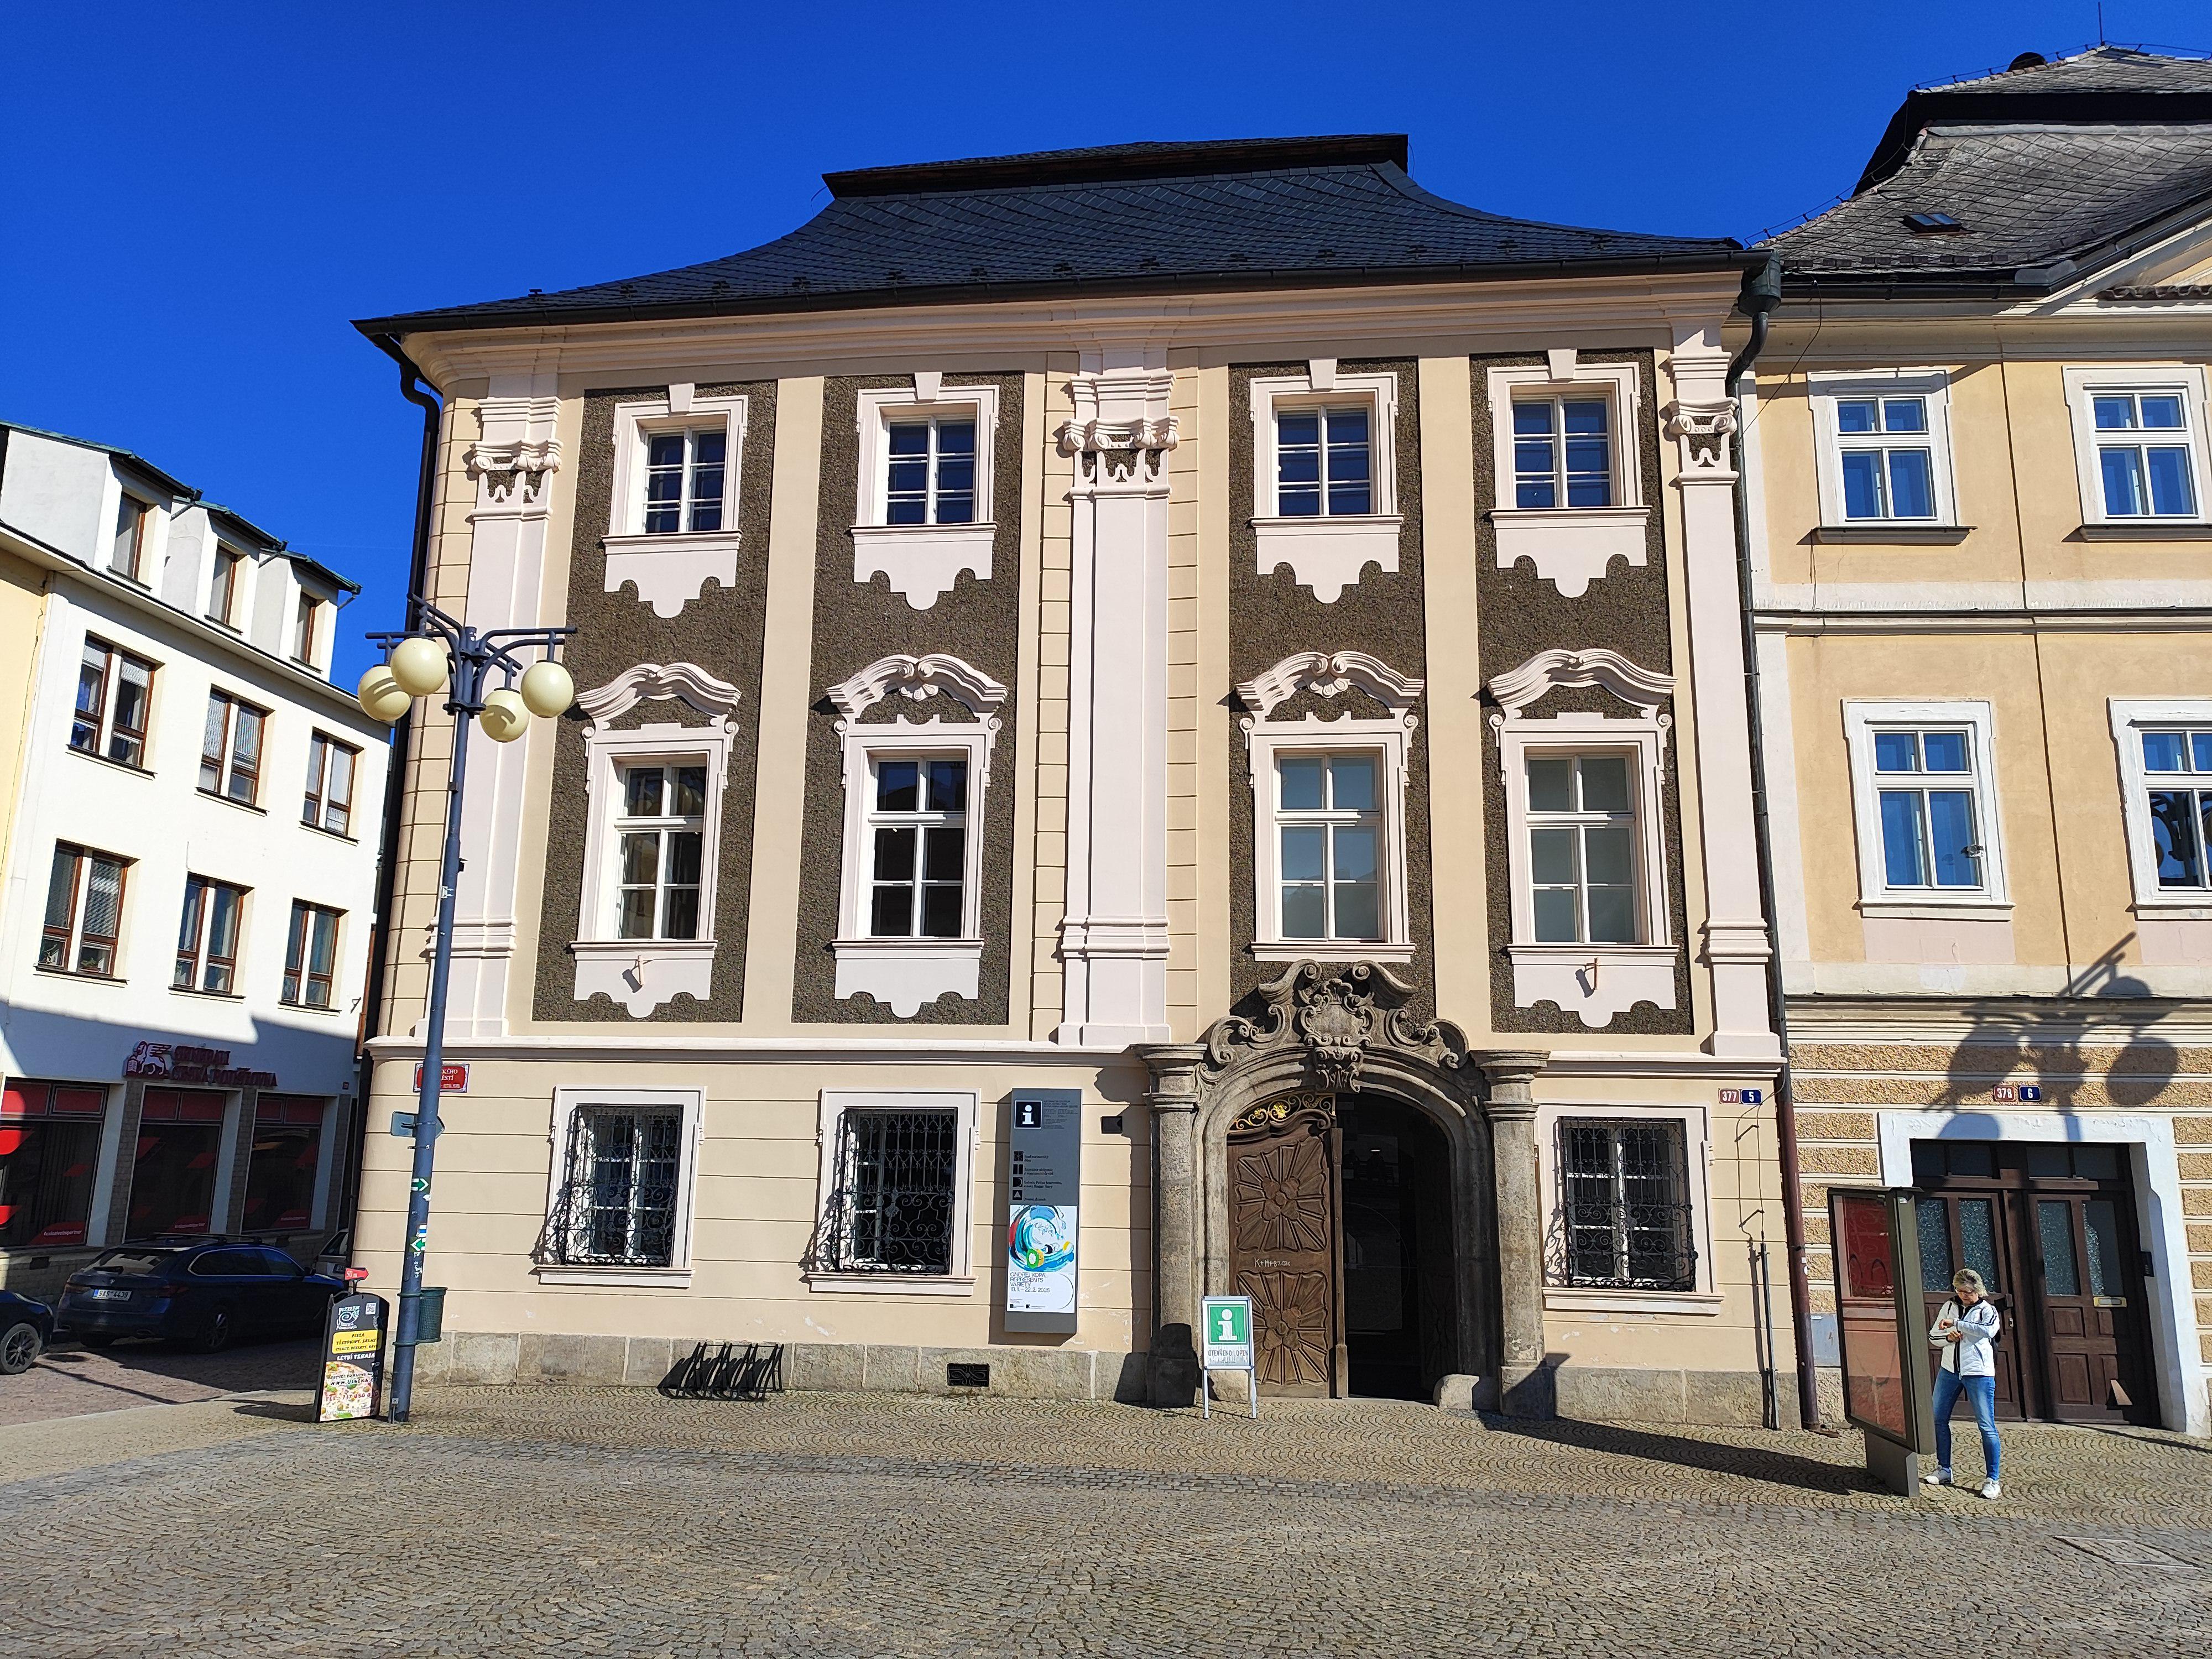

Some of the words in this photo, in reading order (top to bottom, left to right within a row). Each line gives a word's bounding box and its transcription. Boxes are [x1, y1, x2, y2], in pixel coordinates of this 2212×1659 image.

[1722, 1091, 1737, 1102] 377
[1749, 1092, 1754, 1102] 5
[1997, 1088, 2012, 1098] 378
[2027, 1088, 2033, 1099] 6
